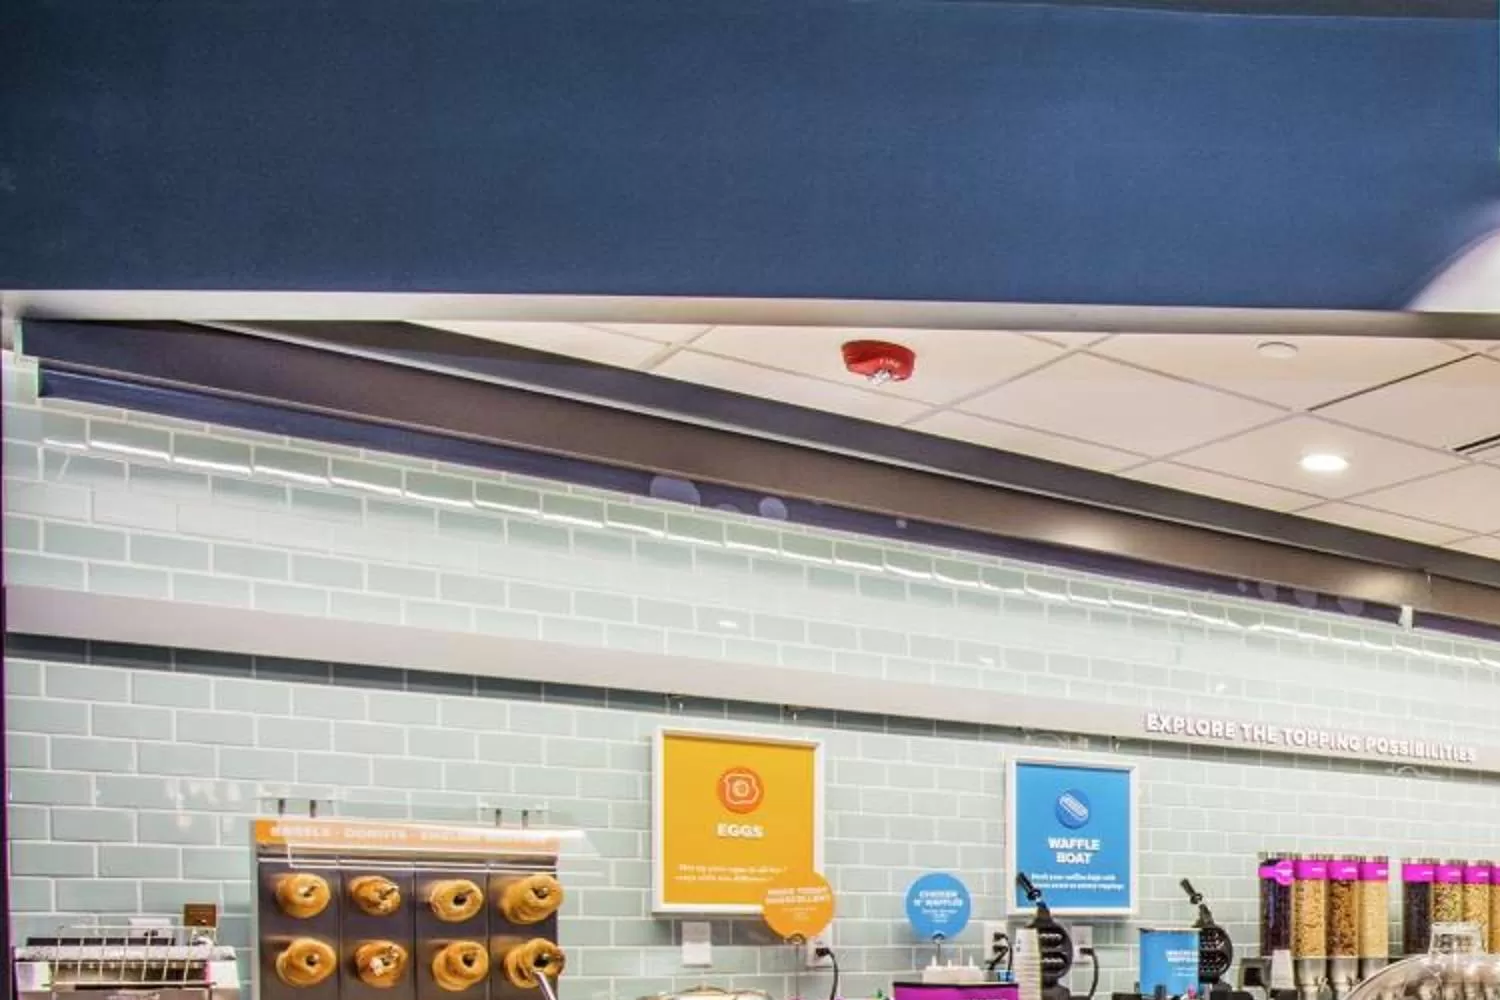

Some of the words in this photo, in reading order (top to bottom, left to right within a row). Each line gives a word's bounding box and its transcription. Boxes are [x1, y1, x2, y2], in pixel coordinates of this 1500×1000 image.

[1146, 712, 1235, 739] EXPLORE
[1240, 722, 1276, 744] THE
[1282, 727, 1360, 752] TOPPING
[1364, 735, 1477, 762] POSSIBILITIES
[717, 823, 764, 839] EGGS
[1047, 836, 1101, 851] WAFFLE
[1056, 851, 1093, 865] BOAT
